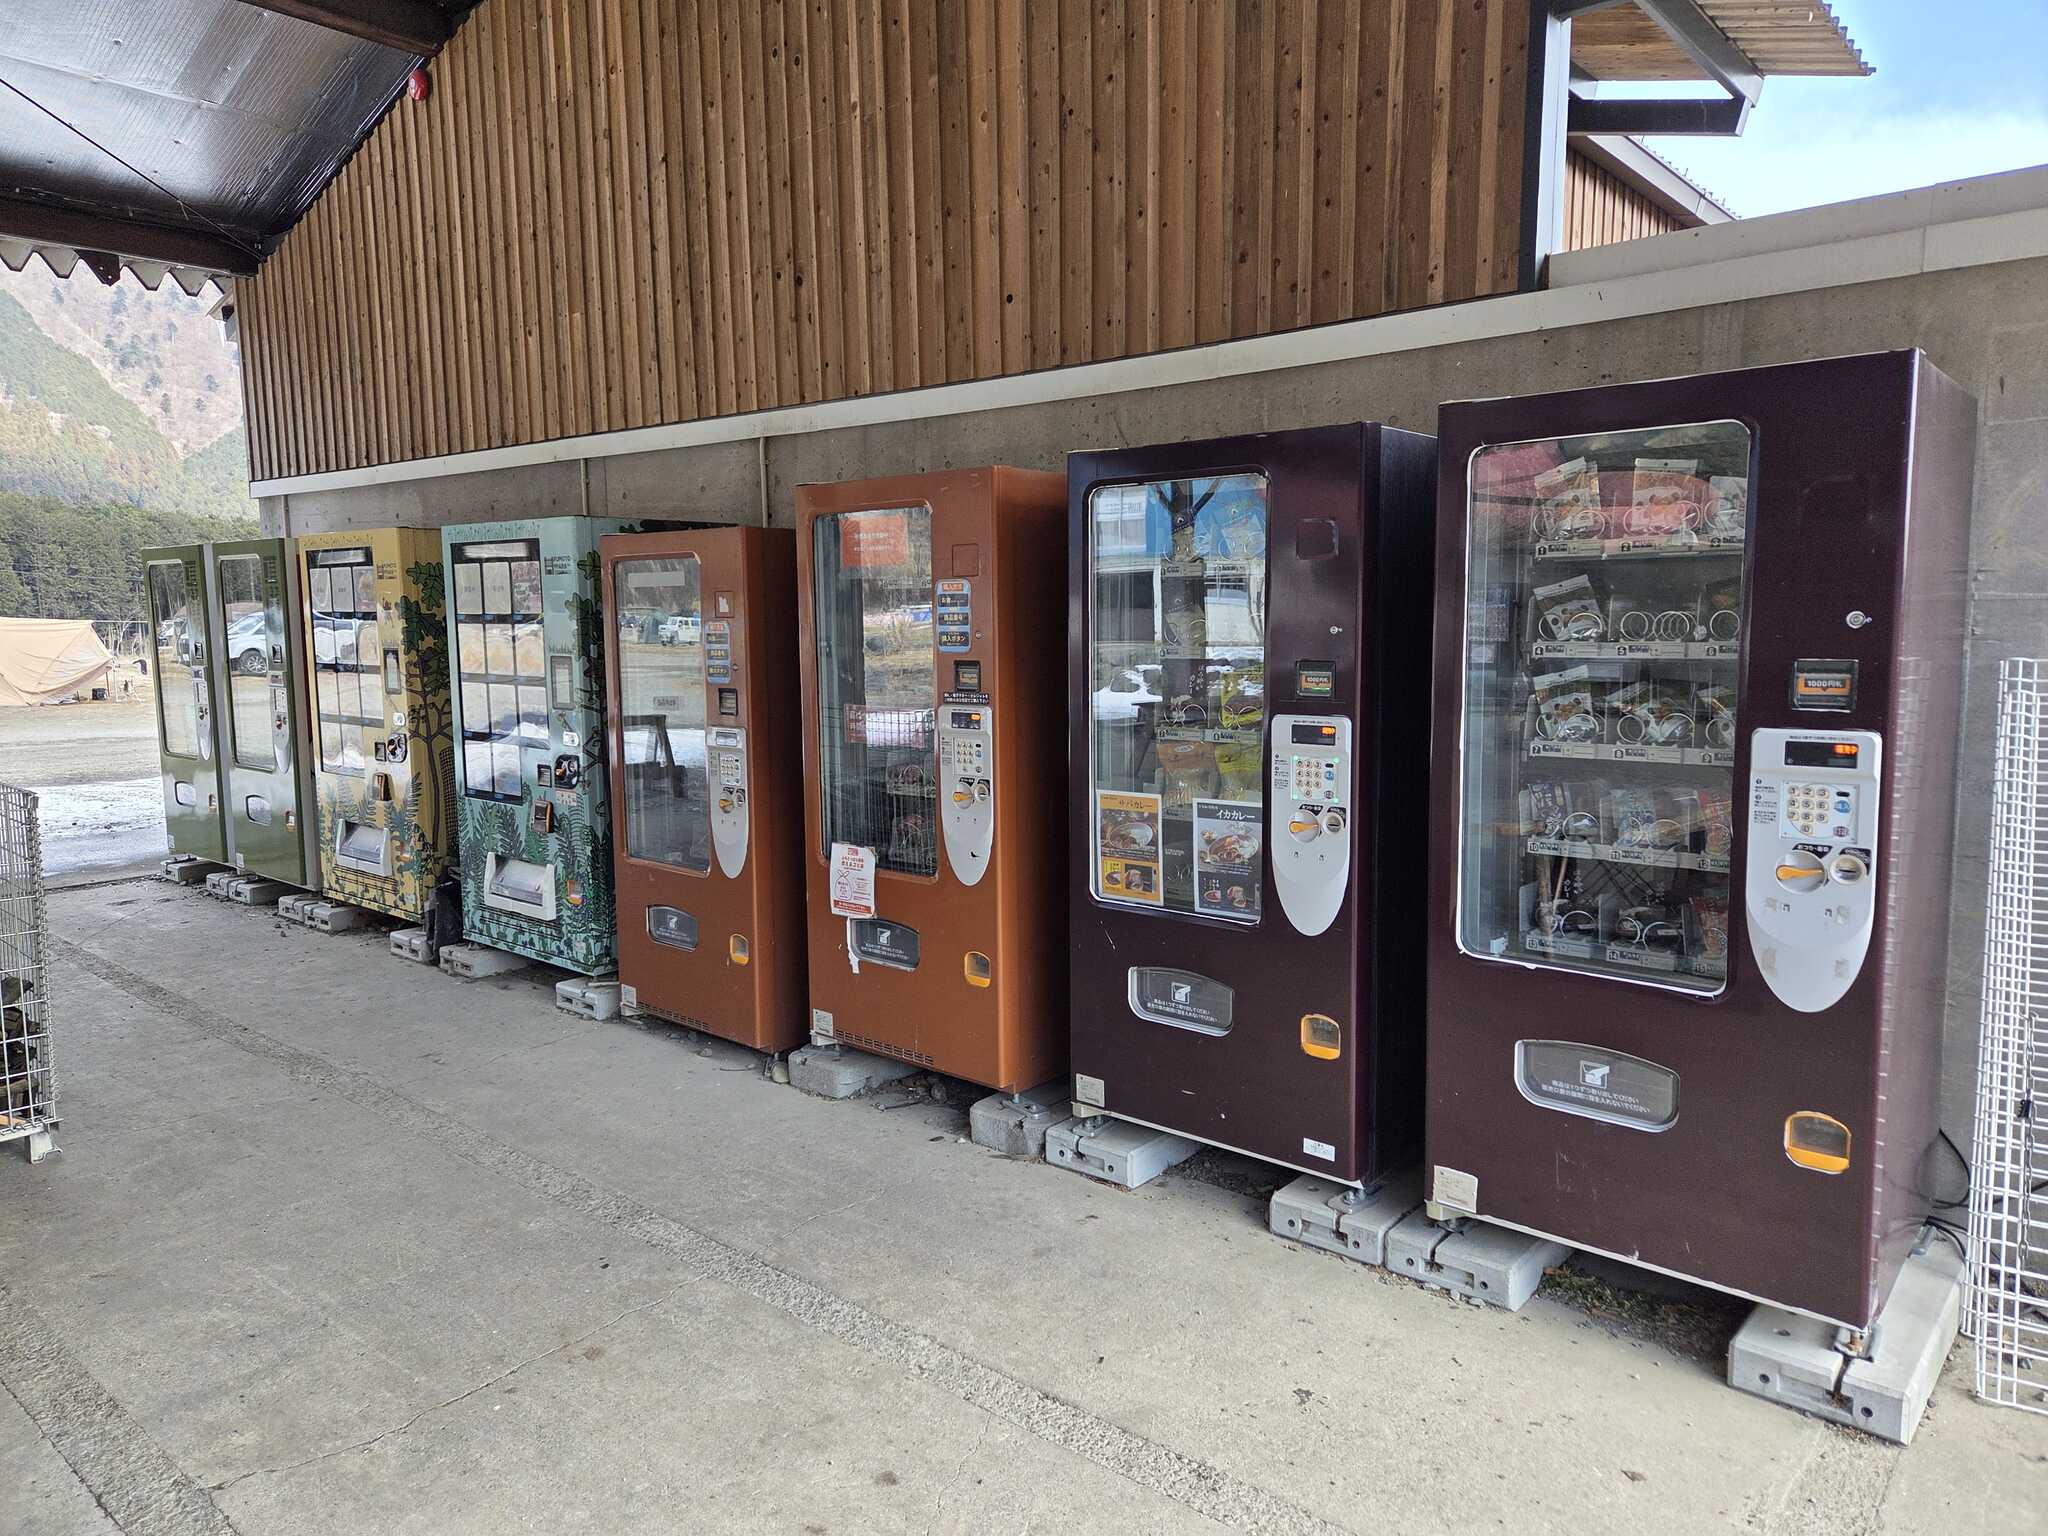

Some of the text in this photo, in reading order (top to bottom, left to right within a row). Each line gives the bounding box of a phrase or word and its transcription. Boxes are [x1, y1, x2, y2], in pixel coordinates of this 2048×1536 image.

[1216, 809, 1256, 821] イカカレー
